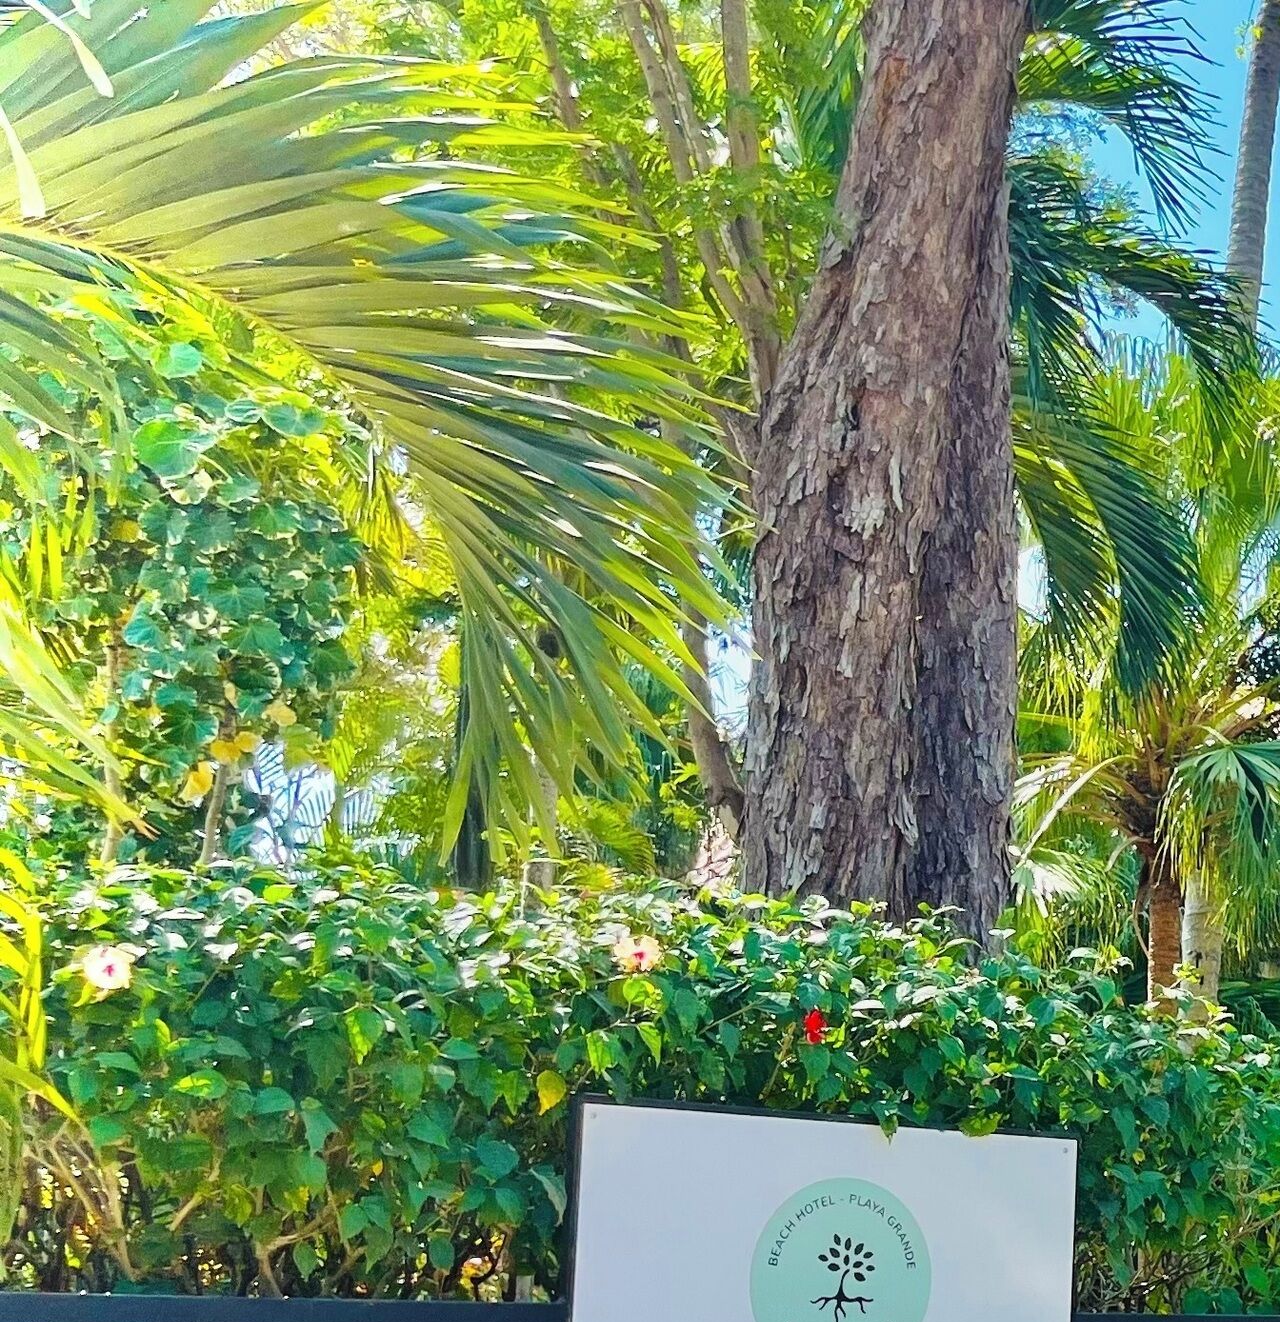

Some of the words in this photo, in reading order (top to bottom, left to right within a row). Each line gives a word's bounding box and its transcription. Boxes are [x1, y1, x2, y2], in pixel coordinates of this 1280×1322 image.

[768, 1219, 795, 1266] BEACH
[795, 1195, 836, 1221] HOTEL
[849, 1193, 886, 1217] PLAYA
[887, 1216, 917, 1269] GRANDE
